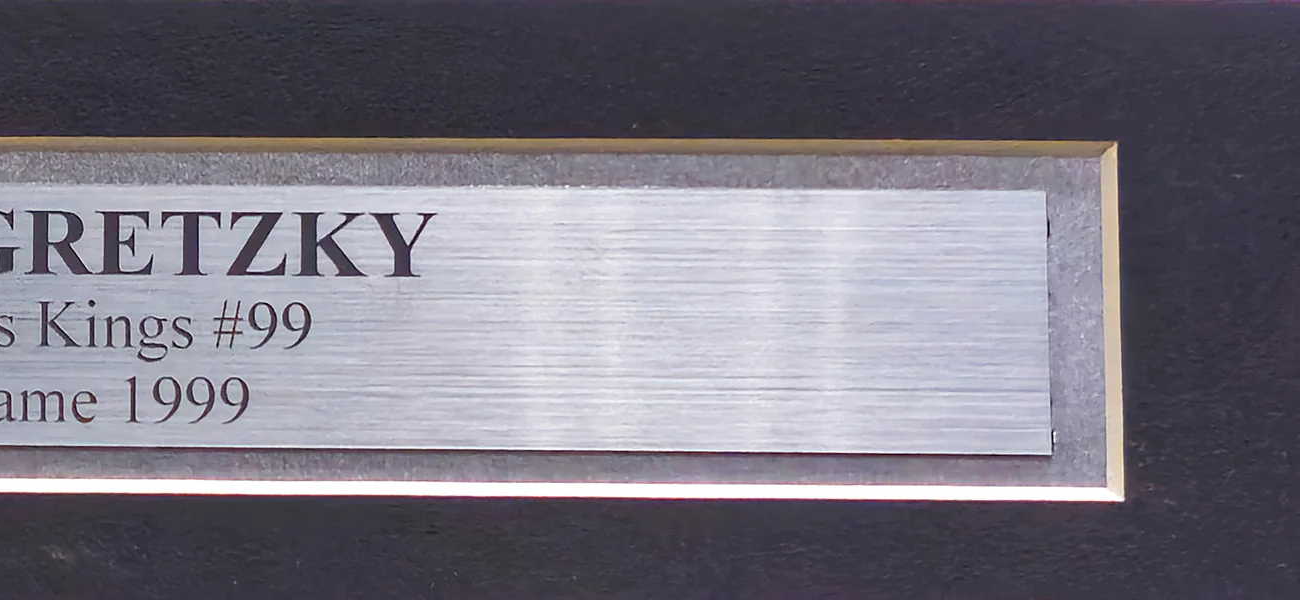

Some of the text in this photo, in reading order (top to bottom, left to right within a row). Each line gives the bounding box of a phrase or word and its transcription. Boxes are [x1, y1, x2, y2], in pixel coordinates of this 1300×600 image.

[38, 299, 194, 363] Kings
[212, 299, 313, 350] #99
[125, 375, 251, 425] 1999
